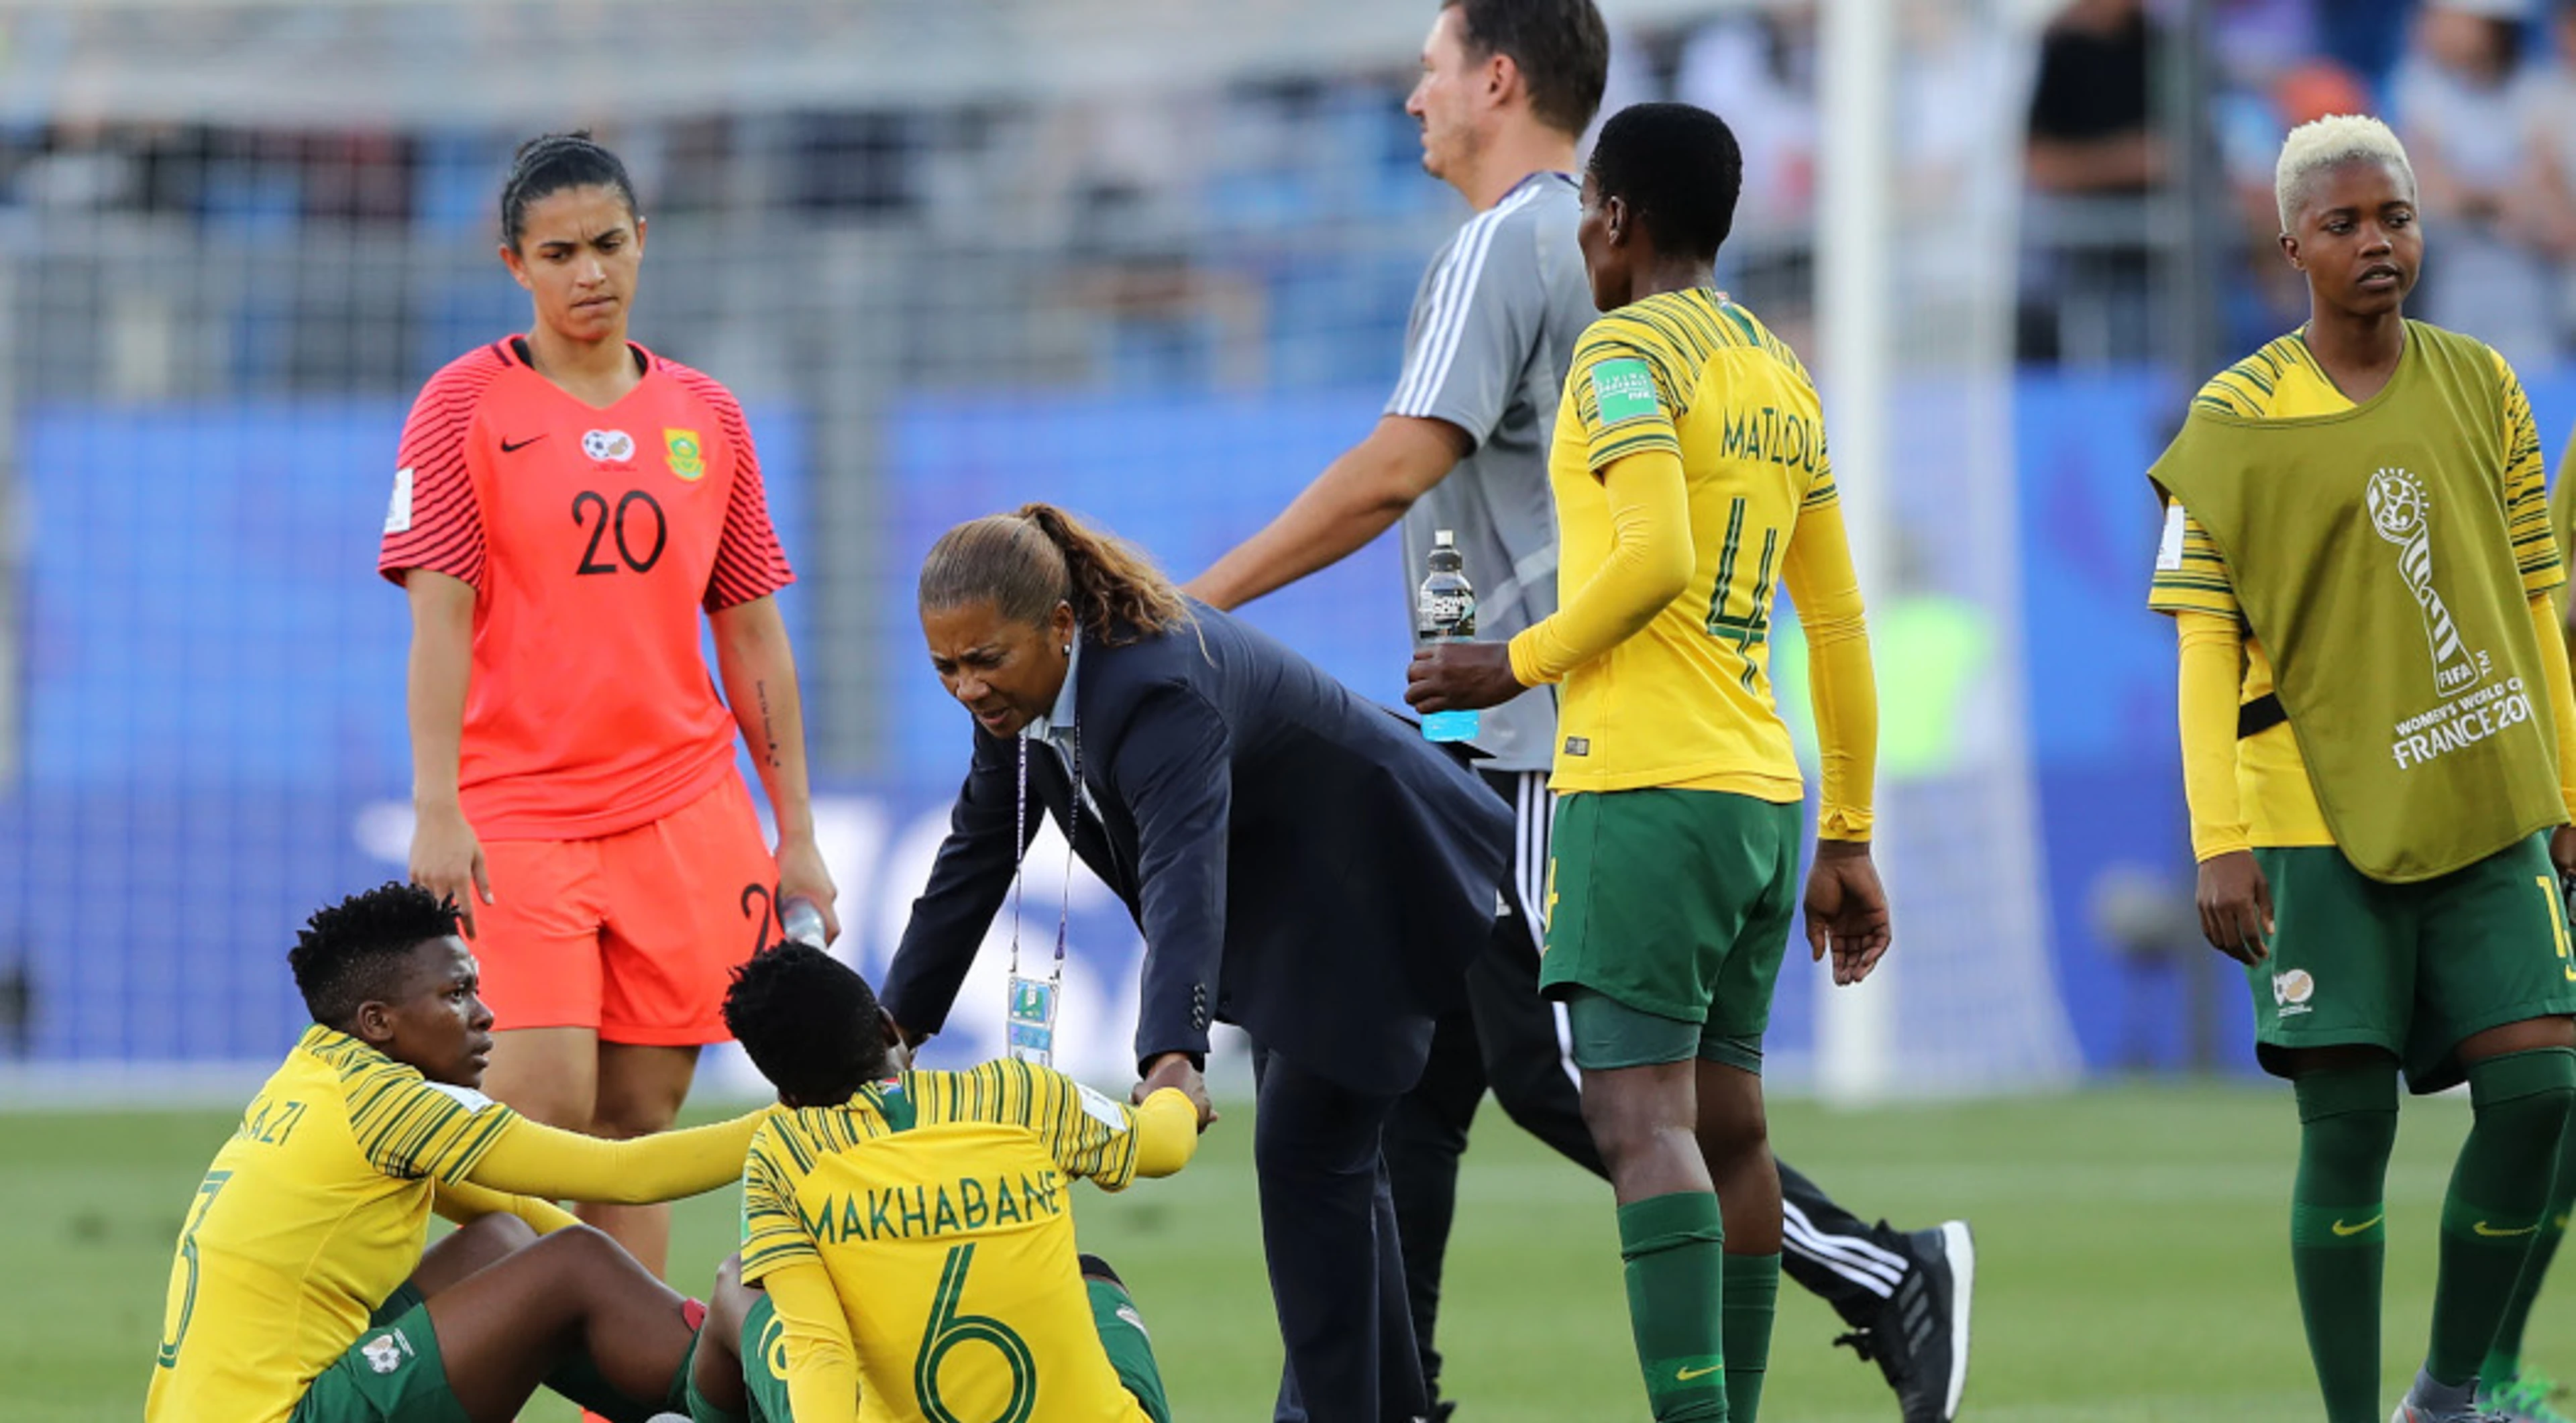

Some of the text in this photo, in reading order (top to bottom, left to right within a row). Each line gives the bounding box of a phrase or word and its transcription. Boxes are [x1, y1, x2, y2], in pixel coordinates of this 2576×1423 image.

[1721, 406, 1820, 472] MATLOU
[572, 490, 667, 575] 20
[1706, 497, 1778, 695] 4
[2395, 676, 2524, 737] WOMEN'S WORLD C
[2438, 663, 2473, 688] FIFA
[2392, 707, 2496, 770] FRANCE
[741, 882, 786, 958] 2
[2536, 876, 2576, 982] 1
[796, 1171, 1060, 1245] MAKHABANE
[915, 1243, 1036, 1423] 6
